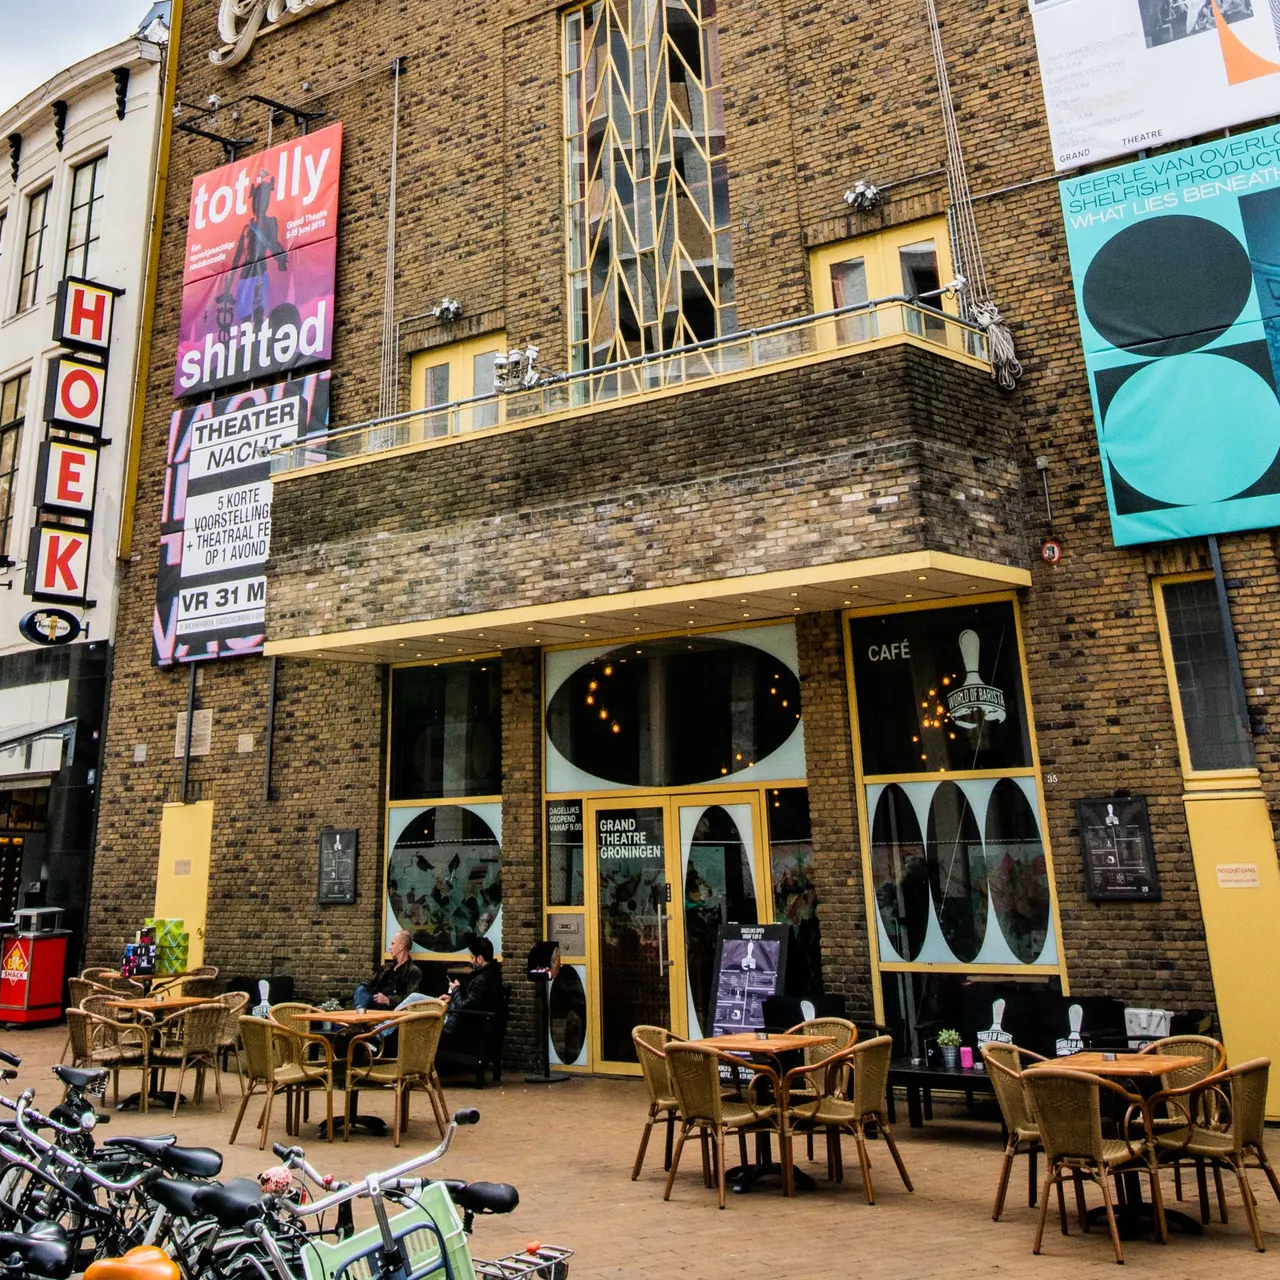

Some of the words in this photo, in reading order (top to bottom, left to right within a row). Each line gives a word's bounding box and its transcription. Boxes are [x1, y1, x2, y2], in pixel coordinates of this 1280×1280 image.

[1059, 148, 1091, 163] GRAND
[1122, 128, 1163, 146] THEATRE
[194, 145, 331, 231] totlly
[1065, 166, 1148, 198] VEERLE
[1151, 154, 1195, 176] VAN
[1069, 178, 1171, 214] SHELFISH
[1070, 204, 1127, 230] WHAT
[1133, 192, 1179, 216] LIES
[195, 401, 296, 444] THEATER
[43, 287, 106, 593] HOEK
[206, 433, 283, 471] NACHT
[217, 495, 224, 511] 5
[226, 487, 260, 509] KORTE
[194, 503, 269, 533] VOORSTELLING
[197, 525, 254, 550] THEATRAAL
[257, 521, 270, 538] FE
[205, 549, 219, 566] OP
[222, 547, 227, 562] 1
[230, 539, 266, 561] AVOND
[182, 590, 209, 613] VR
[215, 585, 239, 608] 31
[247, 581, 265, 603] M
[868, 639, 911, 662] CAFÉ
[948, 689, 970, 707] WORLD
[970, 688, 978, 702] OF
[978, 687, 1006, 707] BARISTA
[1047, 774, 1058, 784] 35
[549, 806, 580, 815] DAGELIJKS
[549, 815, 576, 824] GEOPEND
[549, 824, 569, 832] VANAF
[569, 823, 582, 831] 9.00
[600, 818, 636, 832] GRAND
[600, 832, 647, 845] THEATRE
[600, 845, 661, 859] GRONINGEN
